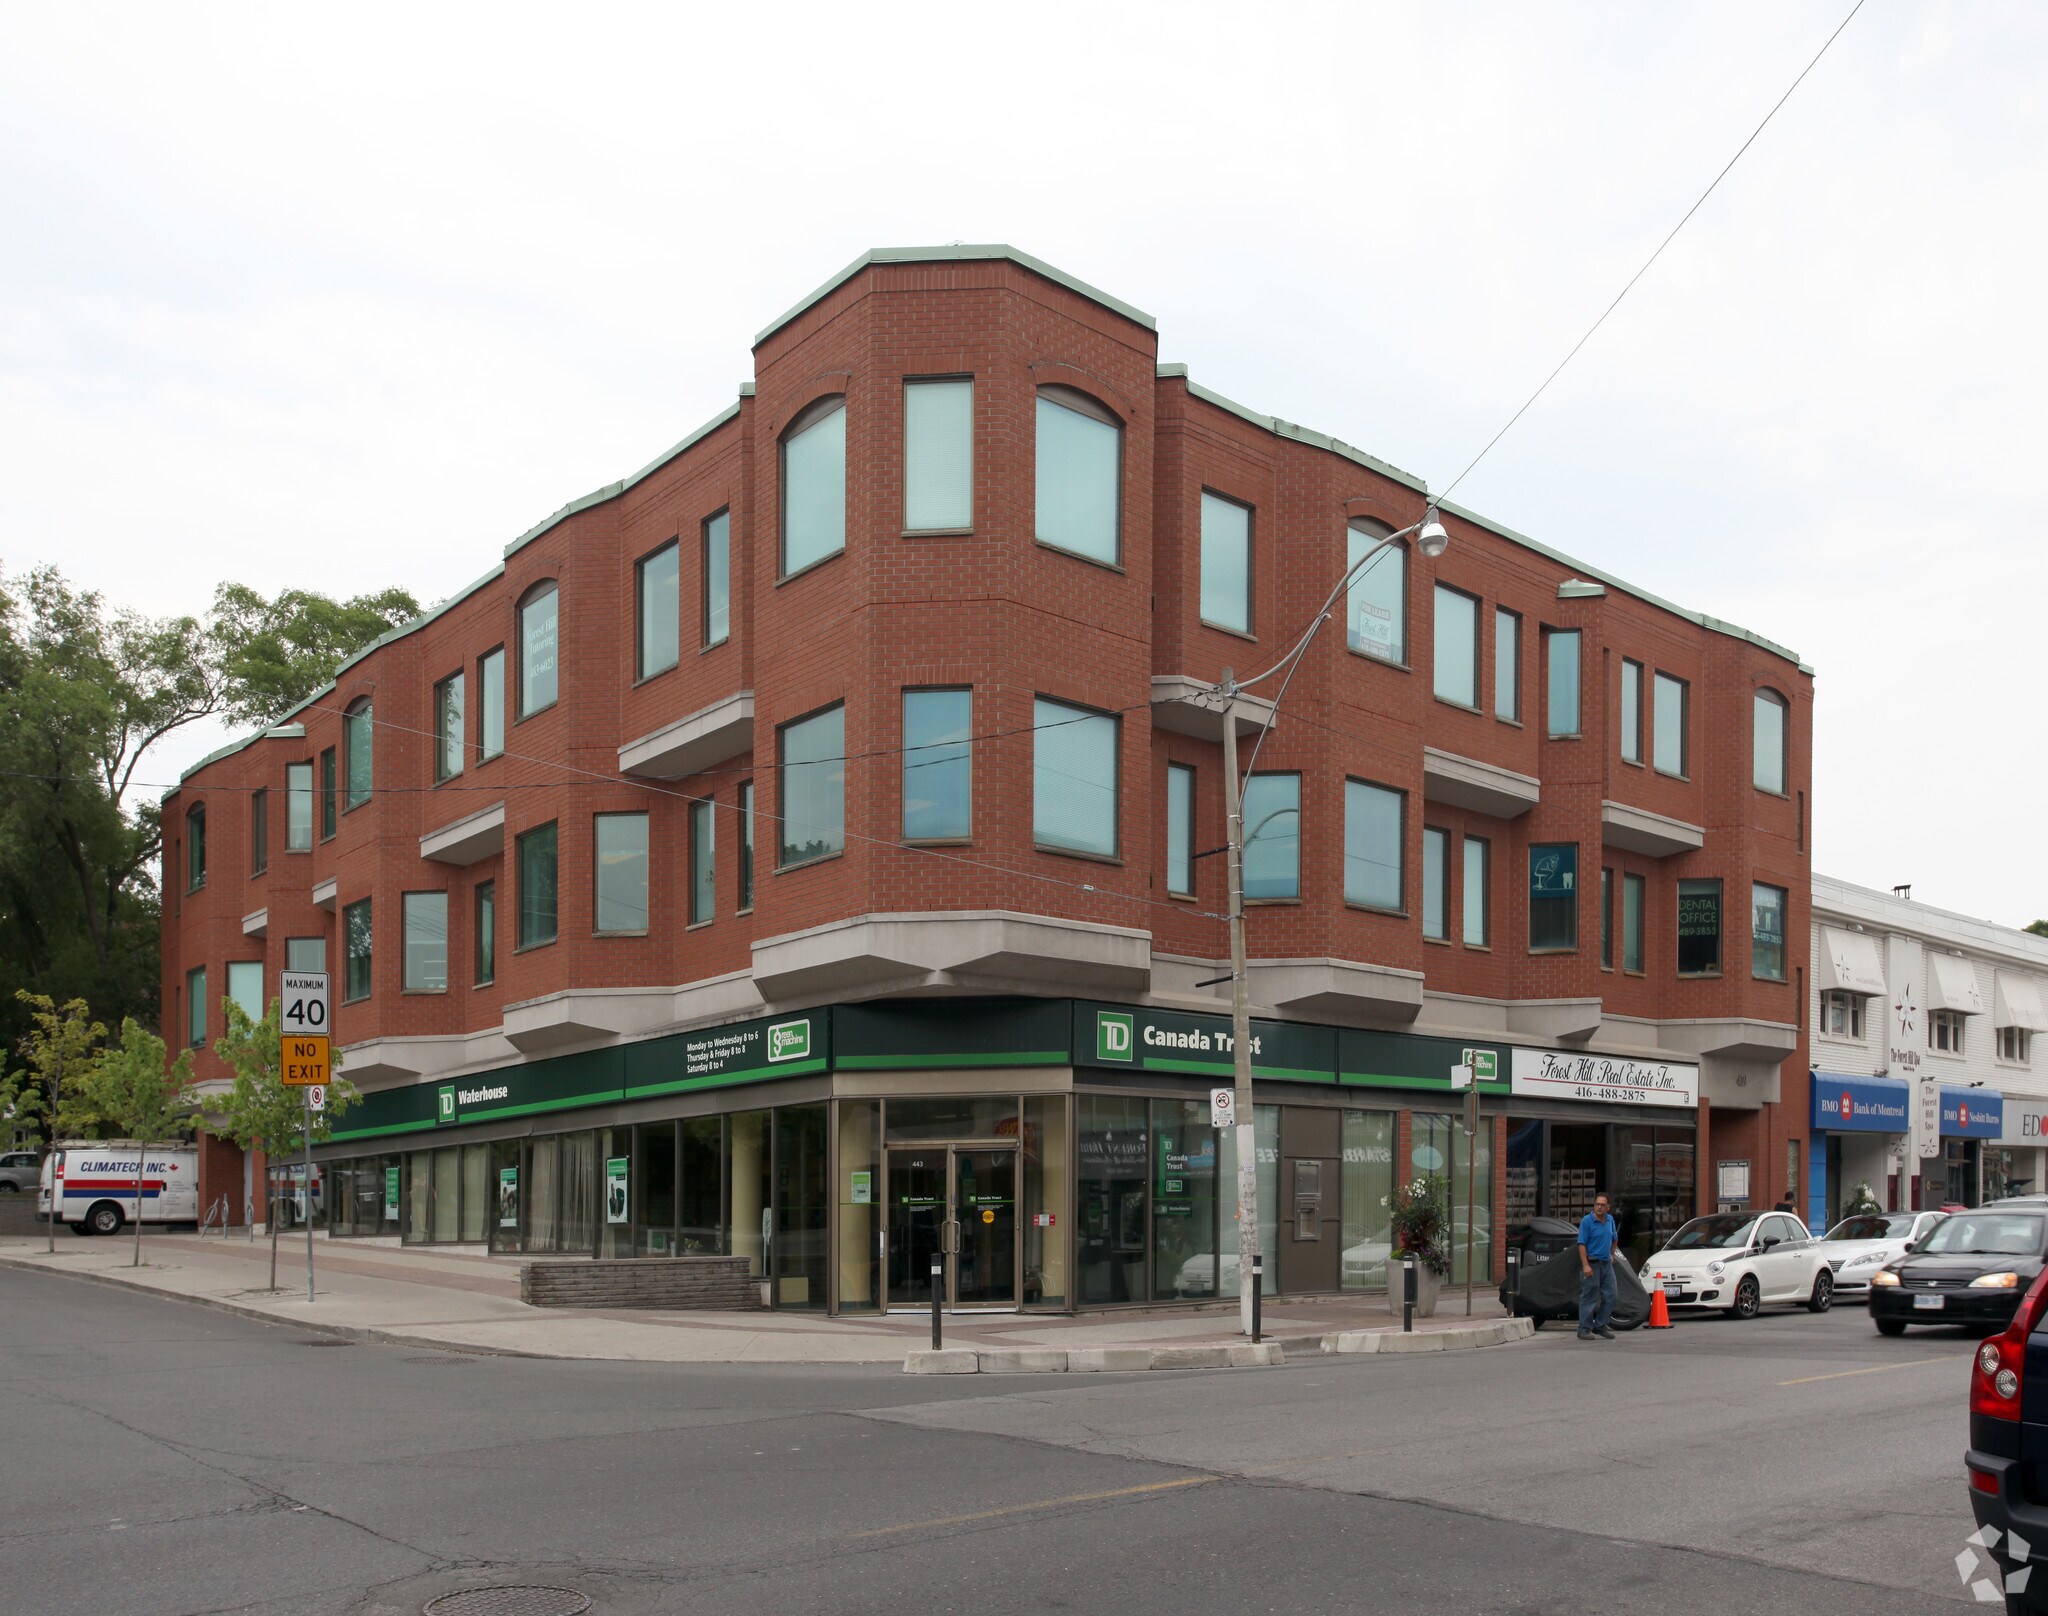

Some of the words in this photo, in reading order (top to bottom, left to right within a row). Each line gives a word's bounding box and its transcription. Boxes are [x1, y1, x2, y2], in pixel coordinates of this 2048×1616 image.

[1371, 607, 1390, 619] LEASE
[1679, 900, 1717, 910] DENTAL
[1679, 912, 1717, 923] OFFICE
[286, 979, 324, 990] MAXIMUM
[286, 999, 325, 1026] 40
[687, 1041, 707, 1052] Monday
[707, 1040, 713, 1049] to
[714, 1034, 743, 1047] Wednesday
[743, 1033, 748, 1042] 8
[748, 1032, 755, 1041] to
[755, 1031, 759, 1040] 6
[1101, 1020, 1130, 1051] TD
[1143, 1025, 1211, 1050] Canada
[1214, 1032, 1261, 1055] Trst
[295, 1043, 316, 1057] NO
[687, 1051, 709, 1063] Thursday
[710, 1050, 714, 1059] &
[714, 1047, 731, 1059] Friday
[730, 1047, 735, 1056] 8
[735, 1046, 741, 1055] to
[741, 1045, 746, 1054] 8
[289, 1064, 323, 1079] EXIT
[687, 1062, 708, 1074] Saturday
[709, 1061, 713, 1070] 8
[713, 1060, 720, 1069] to
[719, 1059, 724, 1068] 4
[1540, 1053, 1573, 1080] Forest
[1574, 1058, 1595, 1082] Hill
[1597, 1060, 1623, 1084] Real
[1626, 1063, 1654, 1087] Estate
[1656, 1065, 1676, 1089] Inc.
[458, 1086, 508, 1105] Waterhouse
[1575, 1086, 1646, 1101] 416-488-2875
[1925, 1086, 1934, 1095] The
[1821, 1100, 1838, 1112] BMO
[1854, 1102, 1870, 1115] Bank
[1870, 1103, 1877, 1115] of
[1877, 1104, 1904, 1117] Montreal
[1922, 1098, 1937, 1107] Forest
[1944, 1109, 1957, 1121] BMO
[1968, 1111, 1986, 1123] Nesbitt
[1986, 1112, 1999, 1124] Burns
[1925, 1122, 1934, 1131] Spa
[146, 1163, 167, 1173] INC.
[1536, 1254, 1550, 1262] Litter
